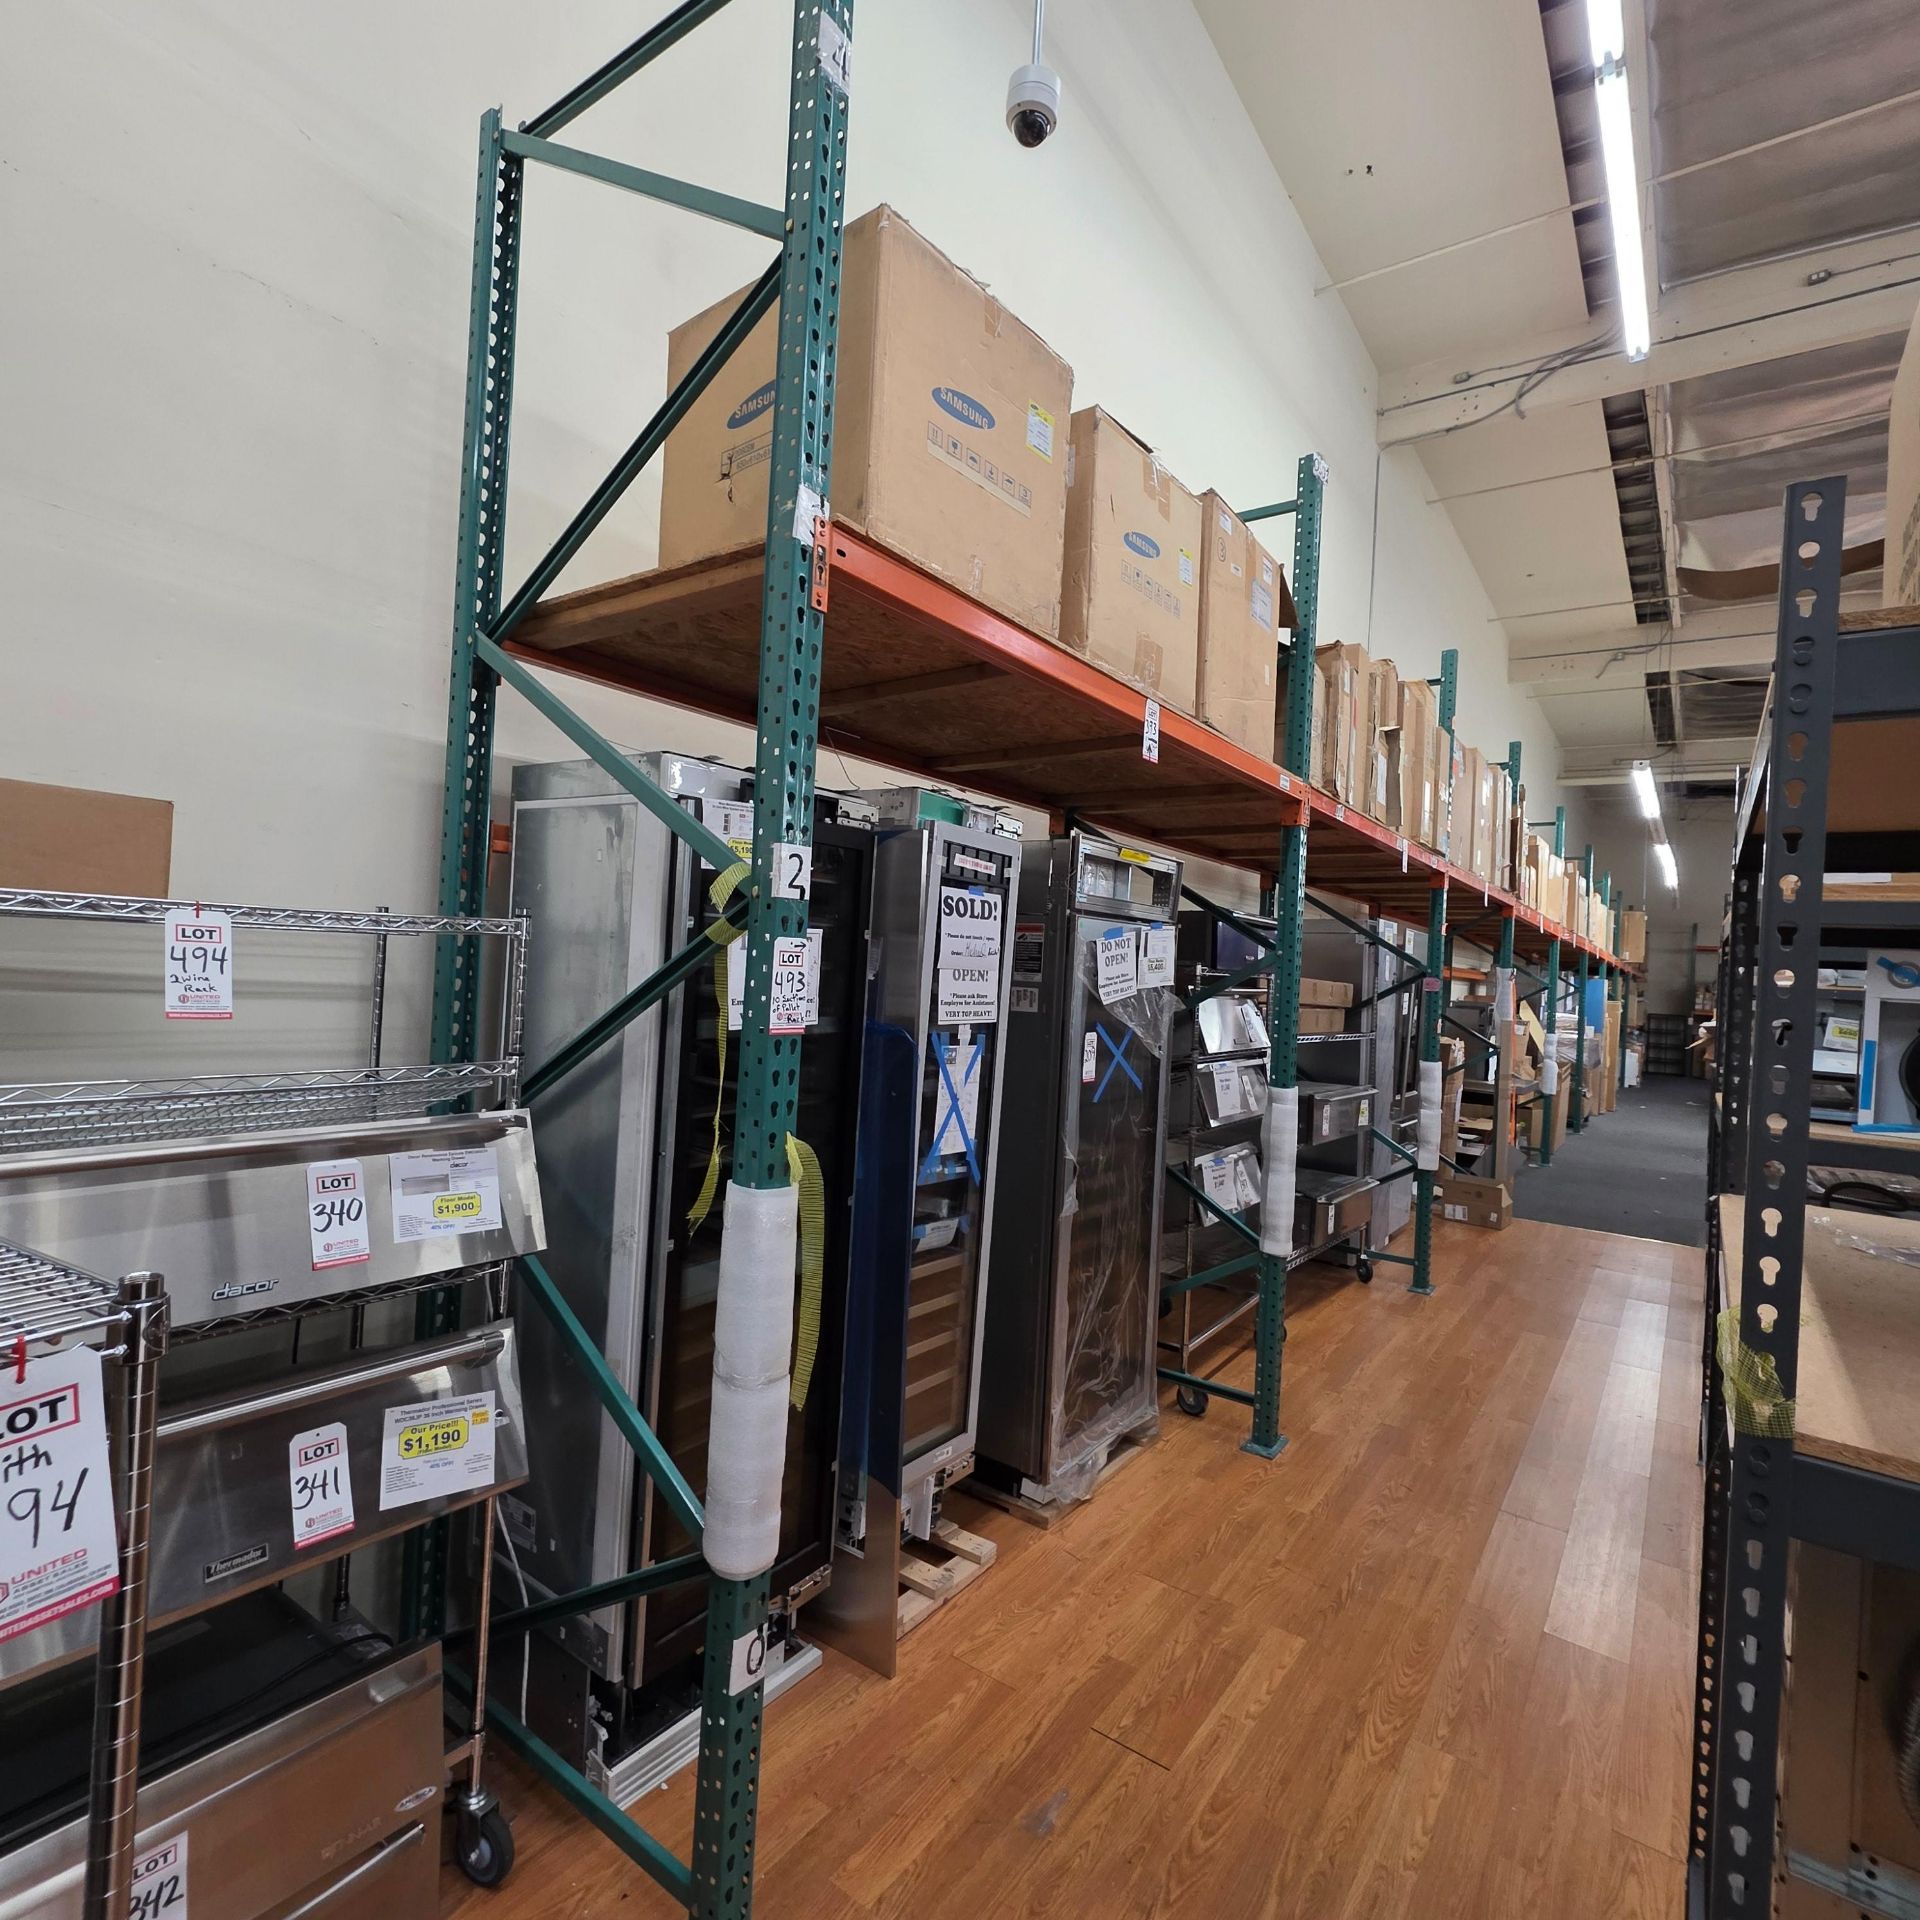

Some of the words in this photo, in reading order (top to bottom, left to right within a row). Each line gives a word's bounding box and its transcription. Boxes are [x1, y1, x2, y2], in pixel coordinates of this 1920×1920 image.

[940, 387, 988, 429] SAMSUNG
[788, 853, 805, 900] 2
[943, 895, 998, 921] SOLD!
[182, 928, 216, 939] LOT
[1101, 942, 1112, 953] DO
[1114, 938, 1131, 951] NOT
[170, 945, 228, 975] 494
[782, 954, 800, 963] LOT
[1105, 953, 1128, 967] OPEN!
[182, 974, 210, 982] Wine
[775, 971, 805, 994] 493
[952, 969, 989, 982] OPEN!
[184, 983, 217, 993] Rack
[772, 996, 780, 1005] 10
[772, 1004, 780, 1013] of
[781, 1003, 800, 1011] Pallet
[787, 1012, 805, 1023] Rack
[321, 1177, 351, 1190] LOT
[440, 1195, 456, 1203] Floor
[312, 1197, 363, 1233] 340
[437, 1202, 474, 1215] $1,900
[212, 1279, 279, 1301] dacor
[0, 1395, 67, 1440] OT
[410, 1426, 426, 1435] Our
[429, 1420, 459, 1432] Price!!!
[403, 1429, 461, 1453] $1,190
[303, 1442, 335, 1462] LOT
[292, 1466, 340, 1510] 341
[11, 1548, 87, 1585] UNITED
[13, 1576, 51, 1594] ASSET
[52, 1560, 88, 1578] SALES
[134, 1850, 172, 1880] LOT
